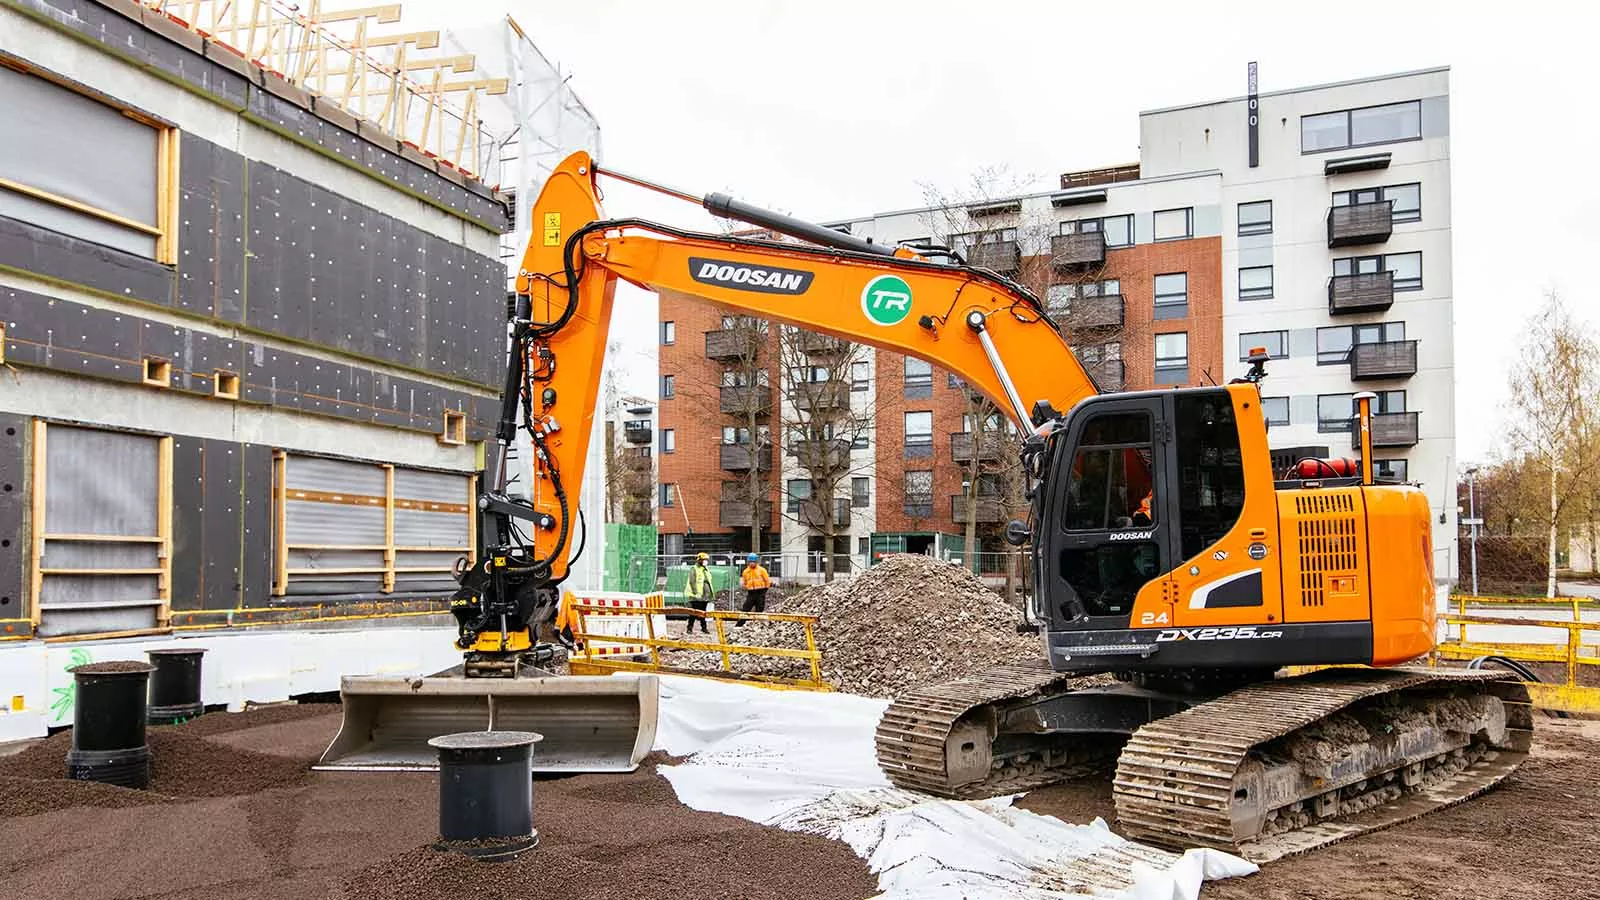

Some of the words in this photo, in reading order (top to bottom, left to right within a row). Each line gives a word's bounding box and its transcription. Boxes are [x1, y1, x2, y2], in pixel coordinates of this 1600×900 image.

[698, 263, 802, 290] DOOSAN
[871, 289, 910, 311] TR
[1109, 532, 1153, 541] DOOSAN
[1141, 611, 1169, 625] 24
[1155, 627, 1283, 642] DX235LCR
